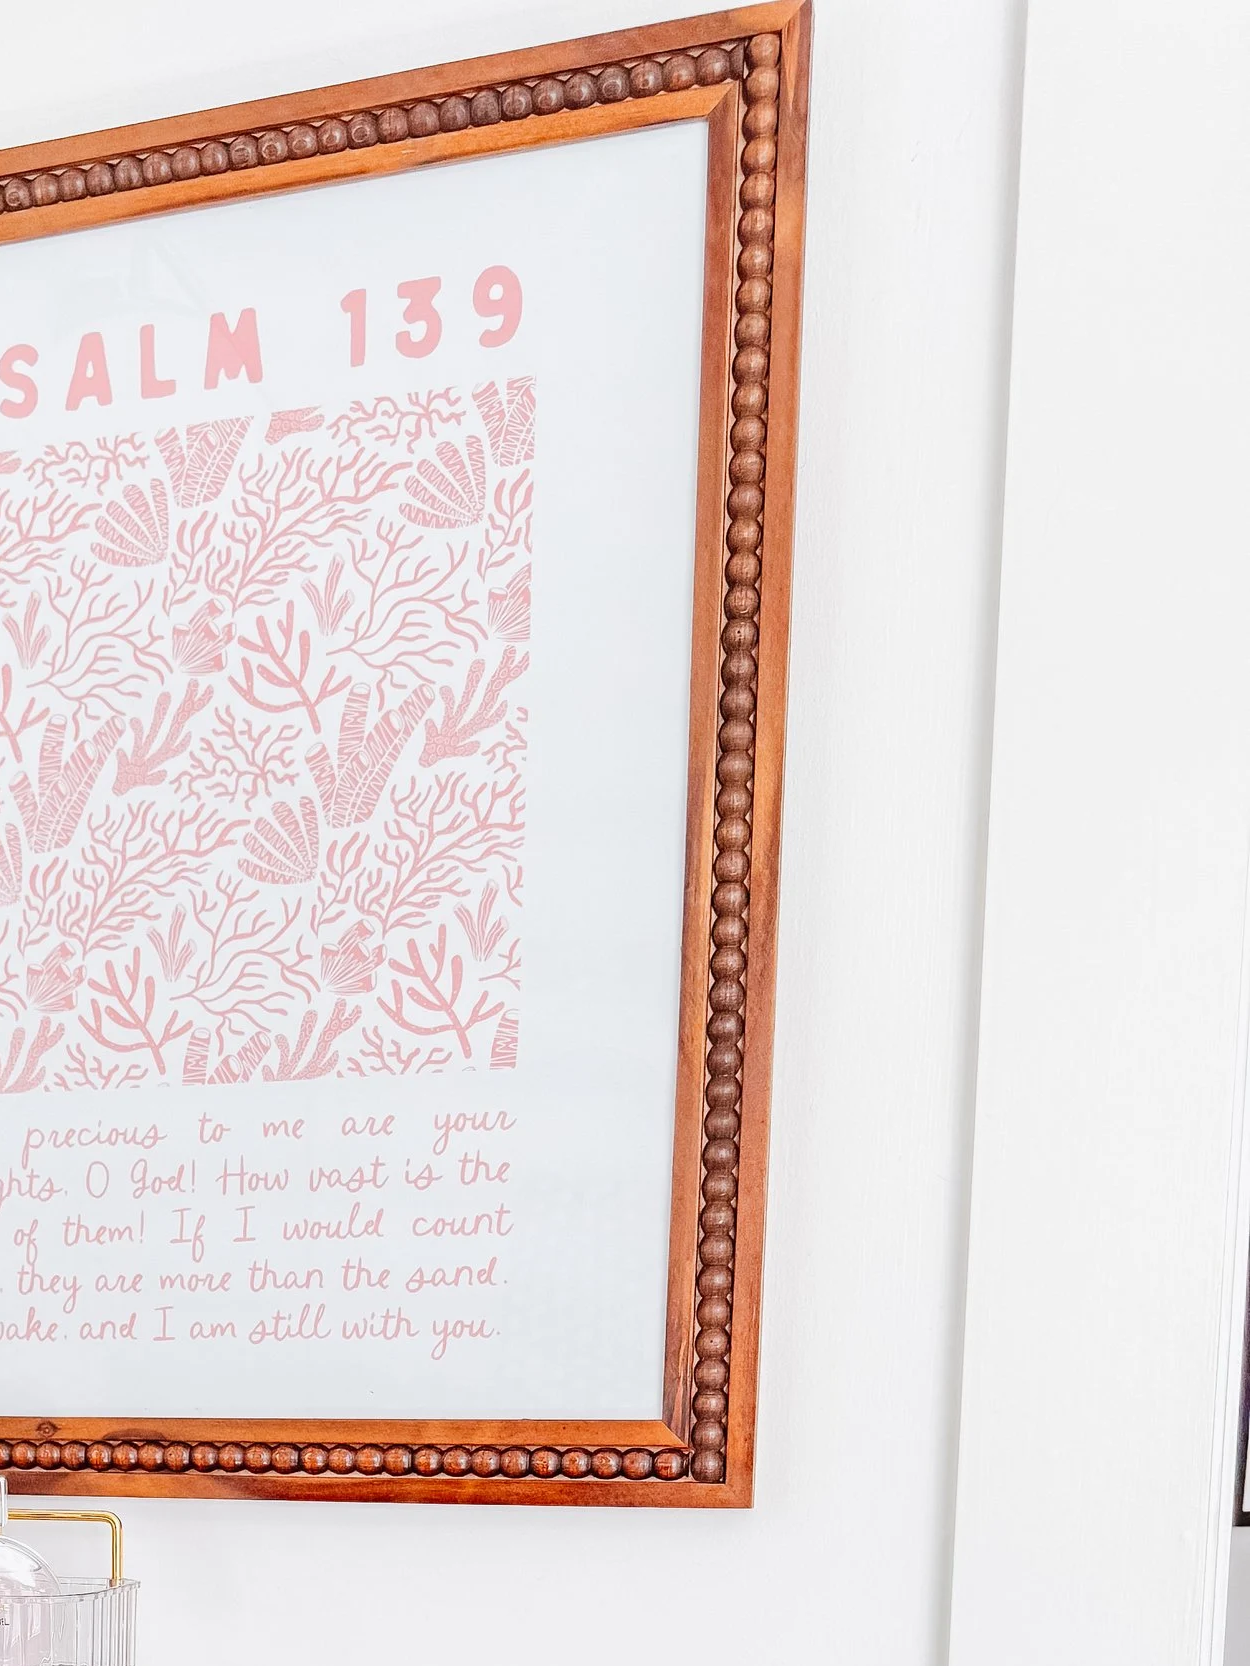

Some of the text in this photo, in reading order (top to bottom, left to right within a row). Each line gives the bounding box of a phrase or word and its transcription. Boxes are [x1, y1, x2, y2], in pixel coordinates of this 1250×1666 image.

[340, 264, 524, 368] 139
[21, 1119, 168, 1170] precious
[197, 1111, 231, 1144] to
[262, 1118, 306, 1140] me
[341, 1114, 396, 1136] are
[432, 1110, 518, 1156] your
[85, 1160, 110, 1199] O
[215, 1154, 289, 1196] How
[309, 1155, 390, 1194] vast
[404, 1158, 443, 1191] is
[458, 1149, 512, 1186] the
[13, 1218, 39, 1267] of
[61, 1209, 145, 1246] them!
[169, 1207, 207, 1263] If
[233, 1205, 257, 1242] I
[281, 1201, 385, 1241] would
[411, 1202, 515, 1237] count
[16, 1263, 83, 1314] they
[94, 1272, 143, 1293] are
[158, 1272, 232, 1292] more
[248, 1258, 324, 1292] than
[341, 1256, 391, 1291] the
[404, 1256, 509, 1294] sand.
[78, 1311, 137, 1341] and
[151, 1306, 176, 1342] I
[188, 1319, 237, 1341] am
[247, 1303, 332, 1345] still
[341, 1306, 420, 1340] with
[430, 1316, 502, 1361] you.
